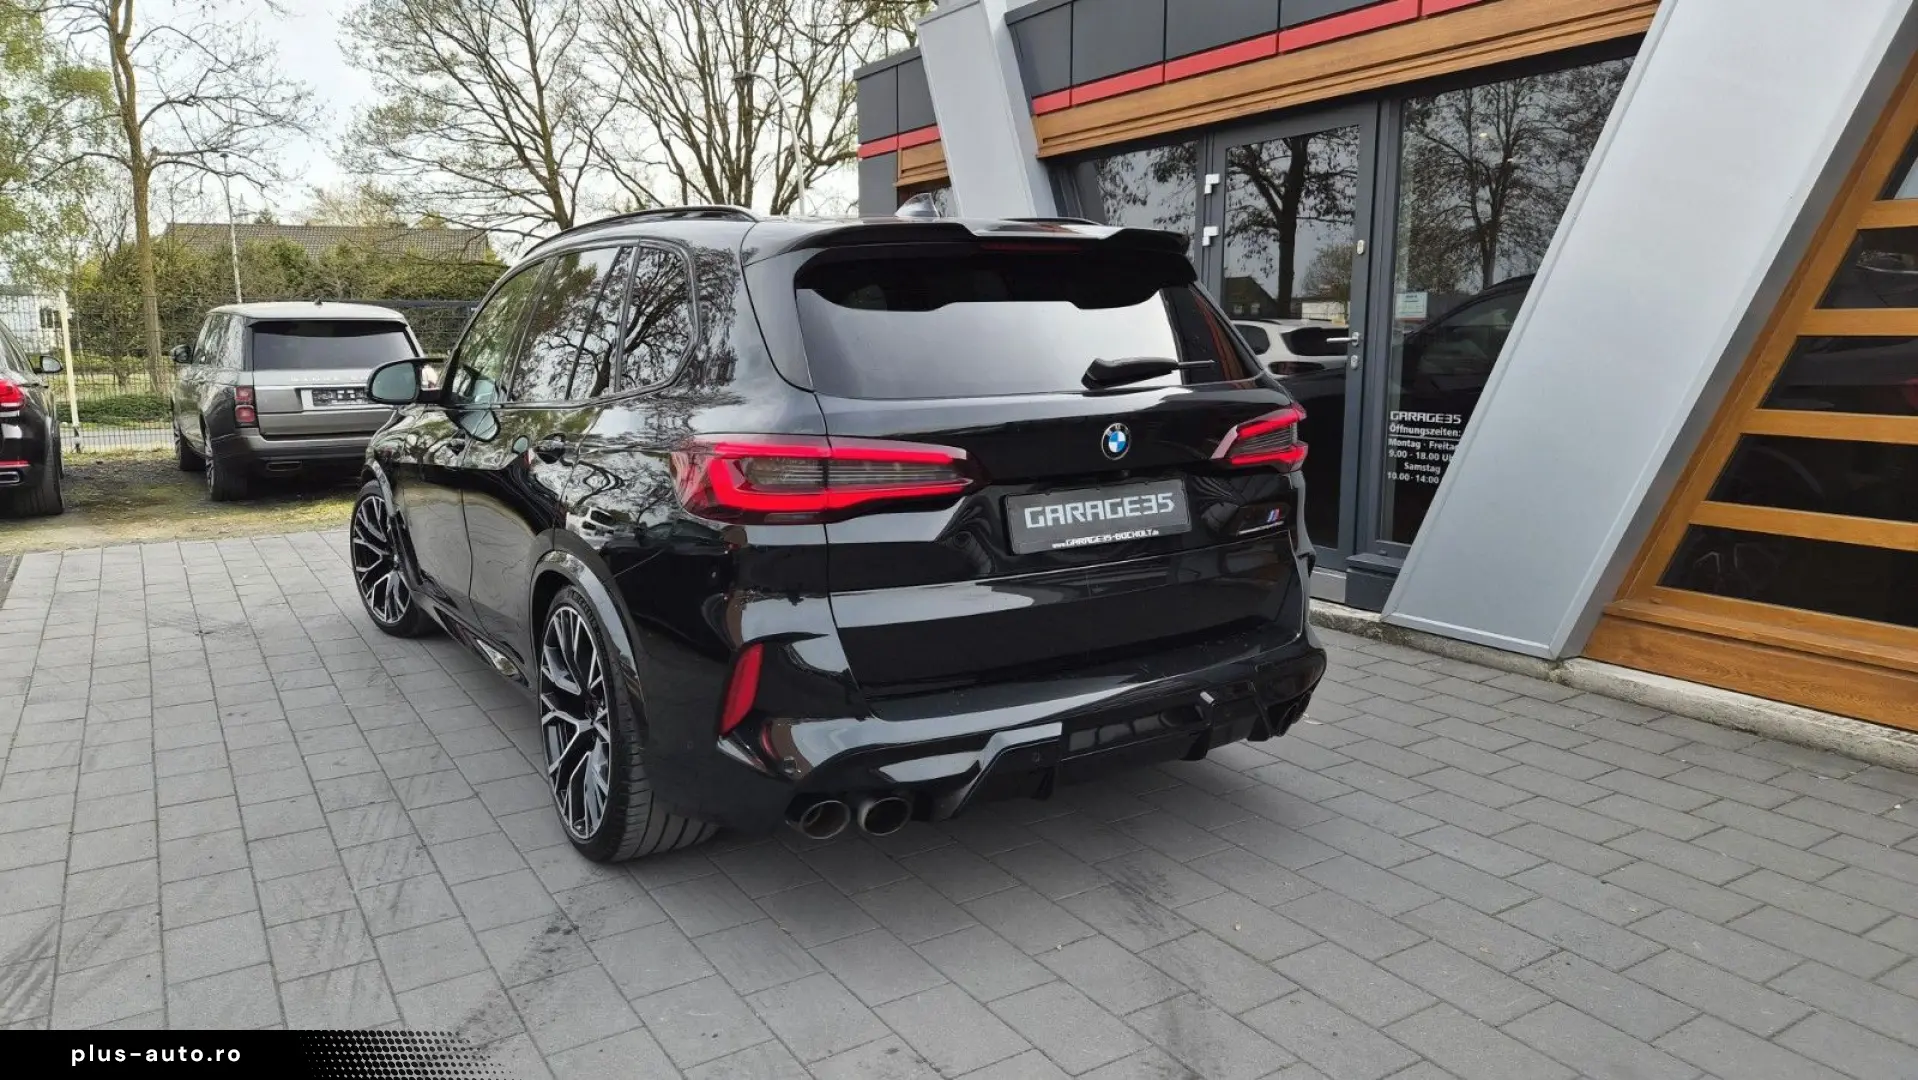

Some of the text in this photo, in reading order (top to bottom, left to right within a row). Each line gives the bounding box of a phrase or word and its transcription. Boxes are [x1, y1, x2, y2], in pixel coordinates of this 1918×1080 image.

[1389, 410, 1462, 424] GARAGE35
[1388, 422, 1461, 437] Öffnungszeiten:
[1387, 438, 1421, 450] Montag
[1429, 440, 1457, 451] Freita
[1388, 449, 1407, 459] 9.00
[1415, 451, 1440, 461] 18.00
[1403, 461, 1441, 475] Samstag
[1023, 492, 1176, 529] GARAGE35
